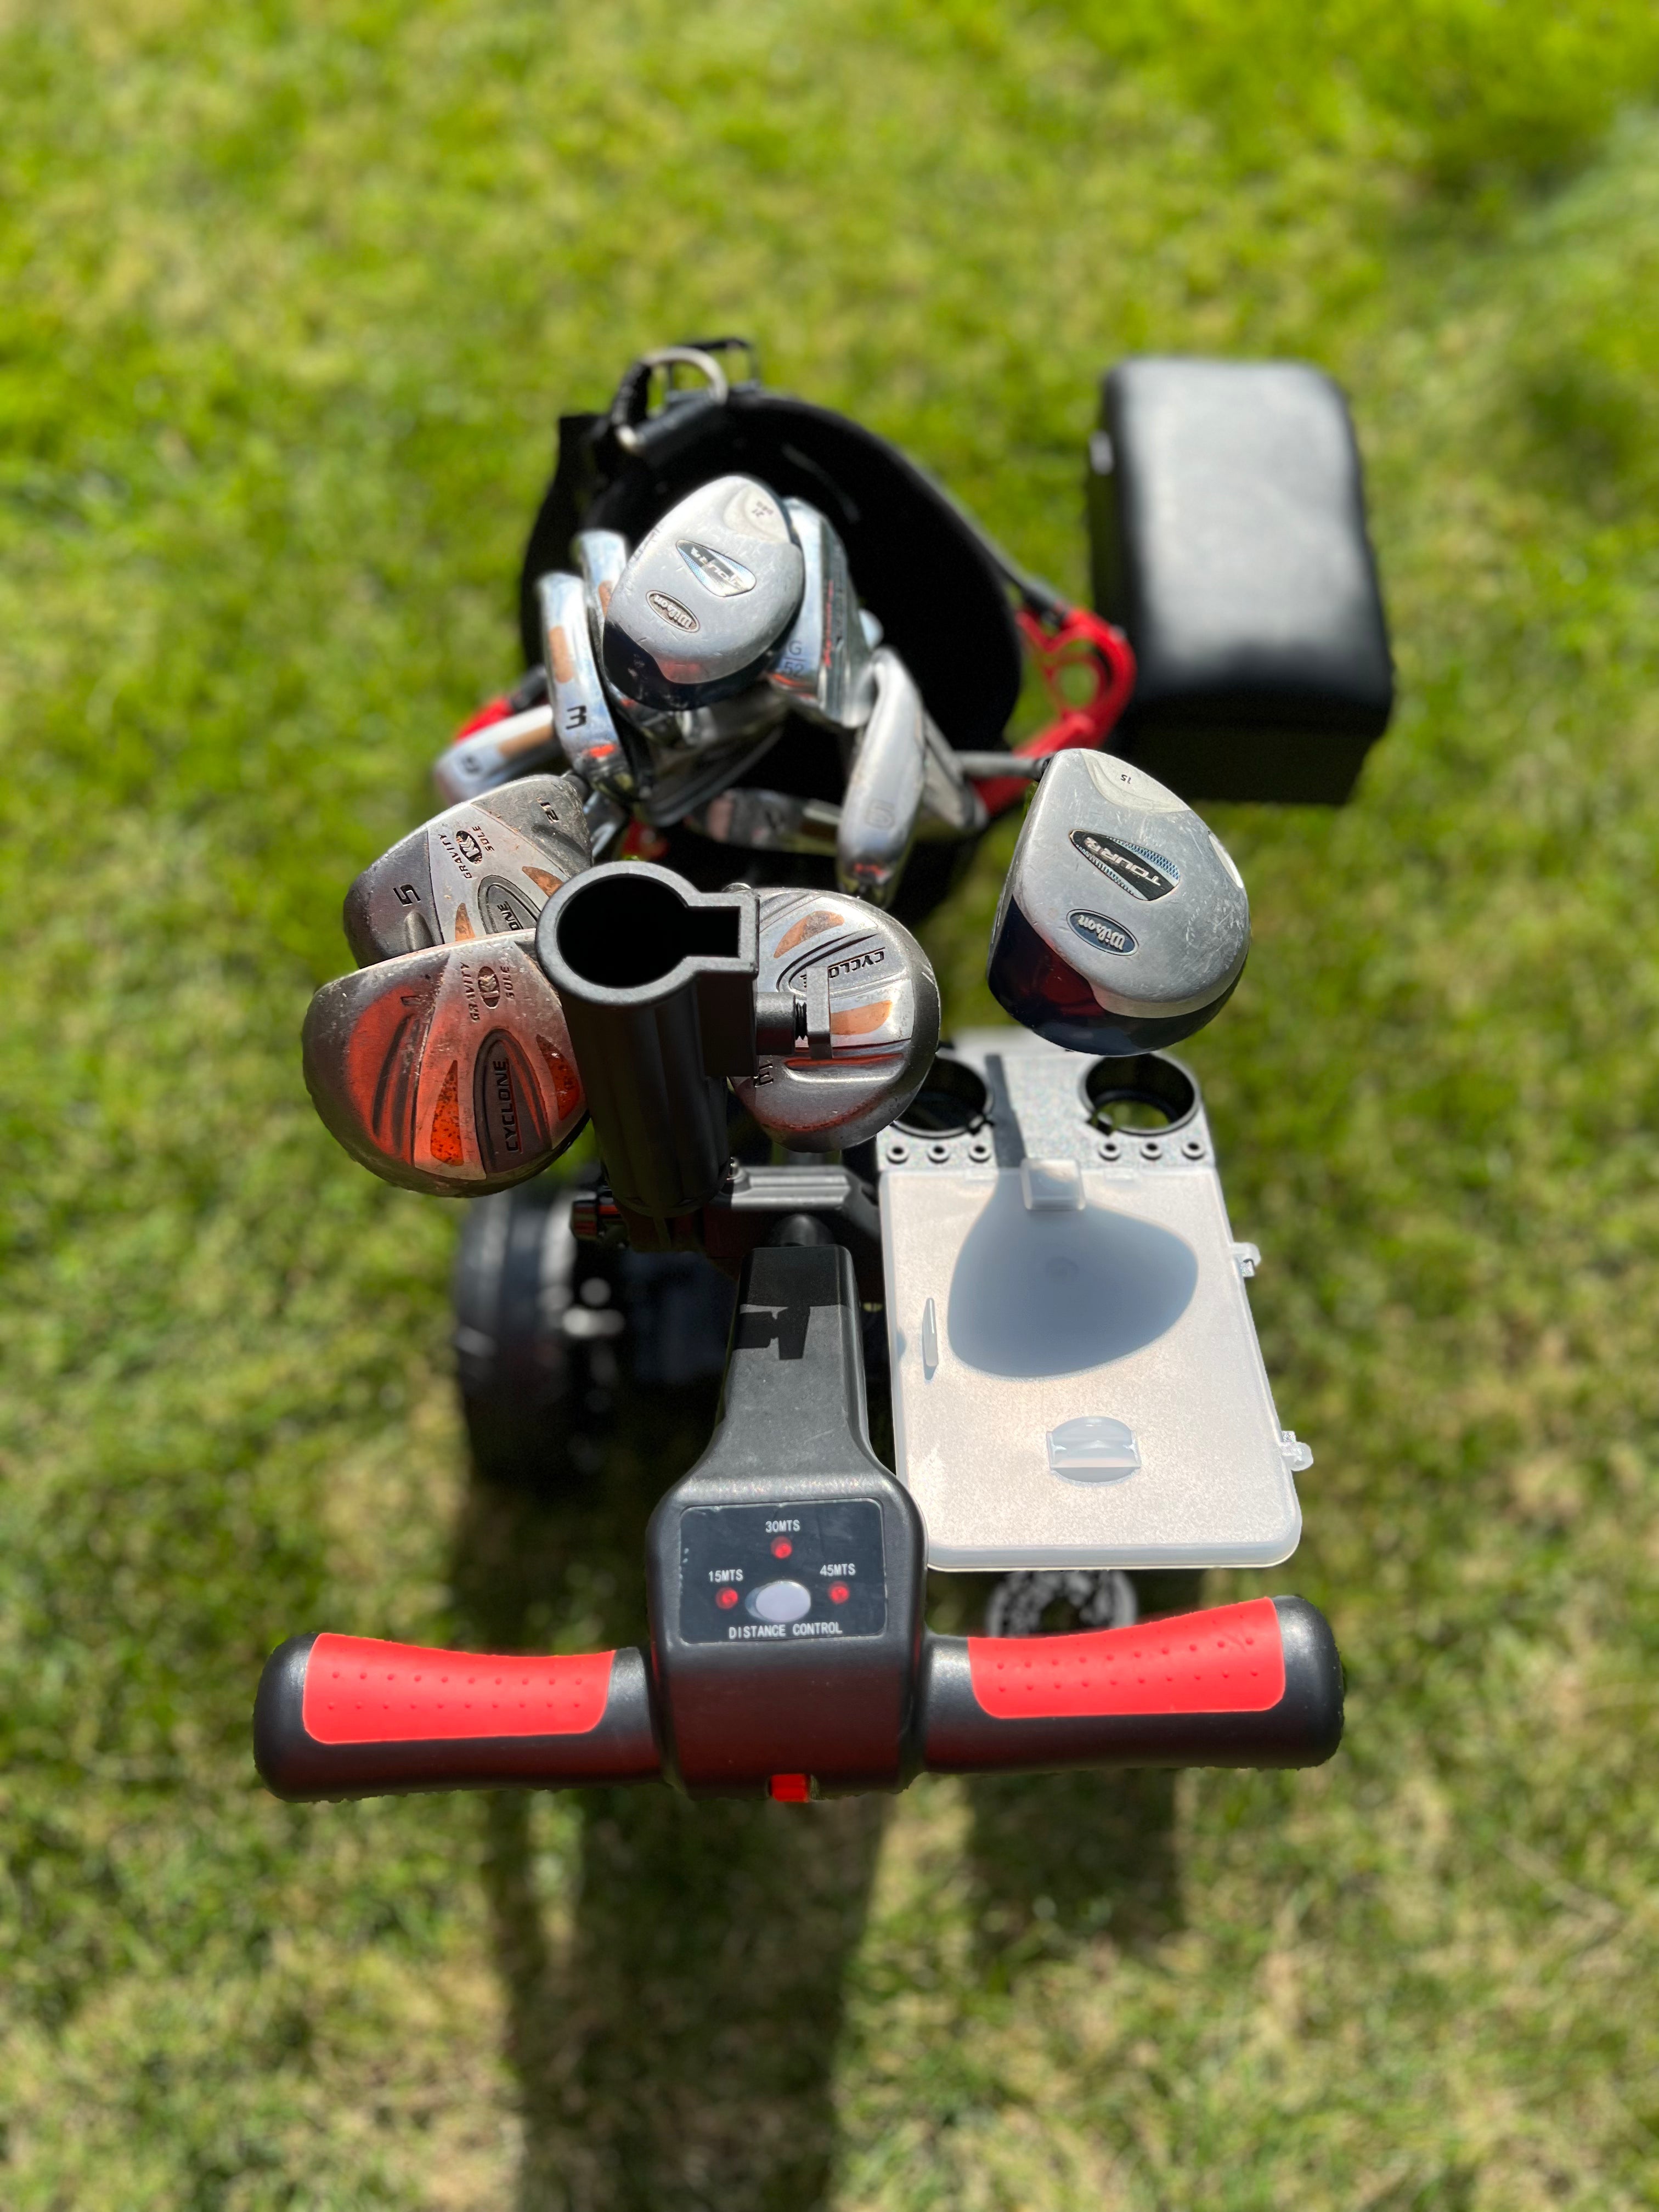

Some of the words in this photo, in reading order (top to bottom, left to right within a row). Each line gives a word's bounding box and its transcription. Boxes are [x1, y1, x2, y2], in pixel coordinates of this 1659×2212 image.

[653, 594, 692, 629] Wilson
[788, 640, 803, 656] G
[784, 661, 804, 679] 52
[566, 705, 587, 730] 3
[1120, 774, 1132, 785] 15
[472, 825, 495, 852] SOLE
[438, 834, 472, 879] GRAVITY
[1101, 848, 1162, 886] TOUR
[393, 883, 422, 907] 5
[1077, 914, 1126, 951] Wilson
[460, 962, 481, 1023] GRAVITY
[500, 966, 515, 999] SOLE
[493, 1059, 518, 1153] CYCLONE
[765, 1519, 801, 1533] 30MTS
[708, 1568, 744, 1583] 15MTS
[820, 1563, 856, 1577] 45MTS
[729, 1624, 787, 1640] DISTANCE
[792, 1622, 843, 1636] CONTROL
